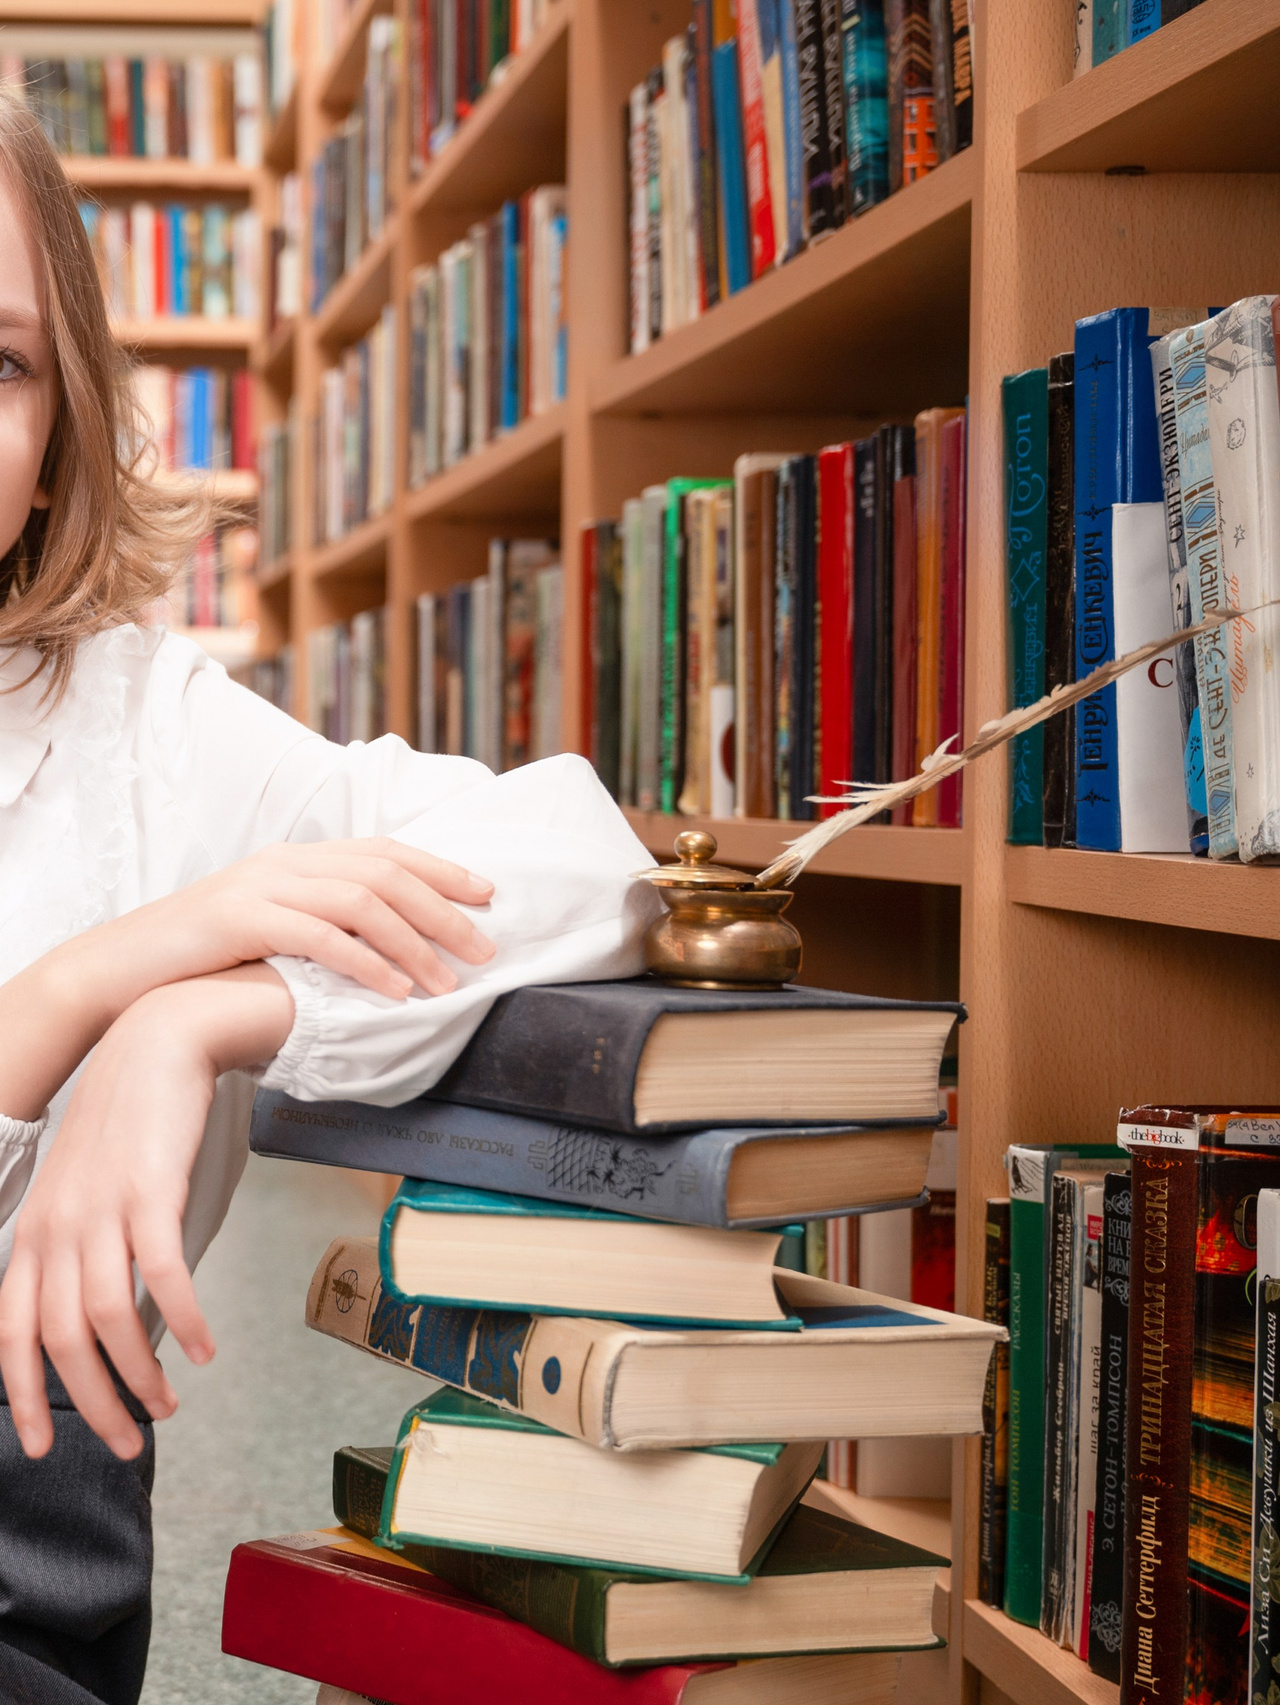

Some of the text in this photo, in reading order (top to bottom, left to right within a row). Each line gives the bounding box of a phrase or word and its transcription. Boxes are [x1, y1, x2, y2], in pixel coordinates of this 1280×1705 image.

[1159, 365, 1184, 544] СЕНТ-ЭКЗЮПЕРИ
[1147, 658, 1174, 689] С
[1078, 688, 1110, 777] ГЕНРИ
[448, 1134, 515, 1158] РАССКАЗЫ
[1056, 1212, 1065, 1233] АД
[1108, 1217, 1131, 1239] КНИ
[1108, 1235, 1124, 1256] НА
[1108, 1255, 1130, 1277] ВРЕМ
[1012, 1271, 1021, 1350] РАССКАЗЫ
[1054, 1280, 1063, 1335] СВЯТЫЕ
[1139, 1176, 1170, 1466] ТРИНАДЦАТАЯ СКАЗКА
[1011, 1389, 1021, 1472] ТОМПСОН
[1052, 1430, 1063, 1504] Жильбер
[1103, 1333, 1123, 1530] СЕТОН-ТОМПСОН
[1257, 1311, 1277, 1655] Лиза Си Девушки из Шанхая
[1133, 1494, 1163, 1696] Диана Сеттерфилд
